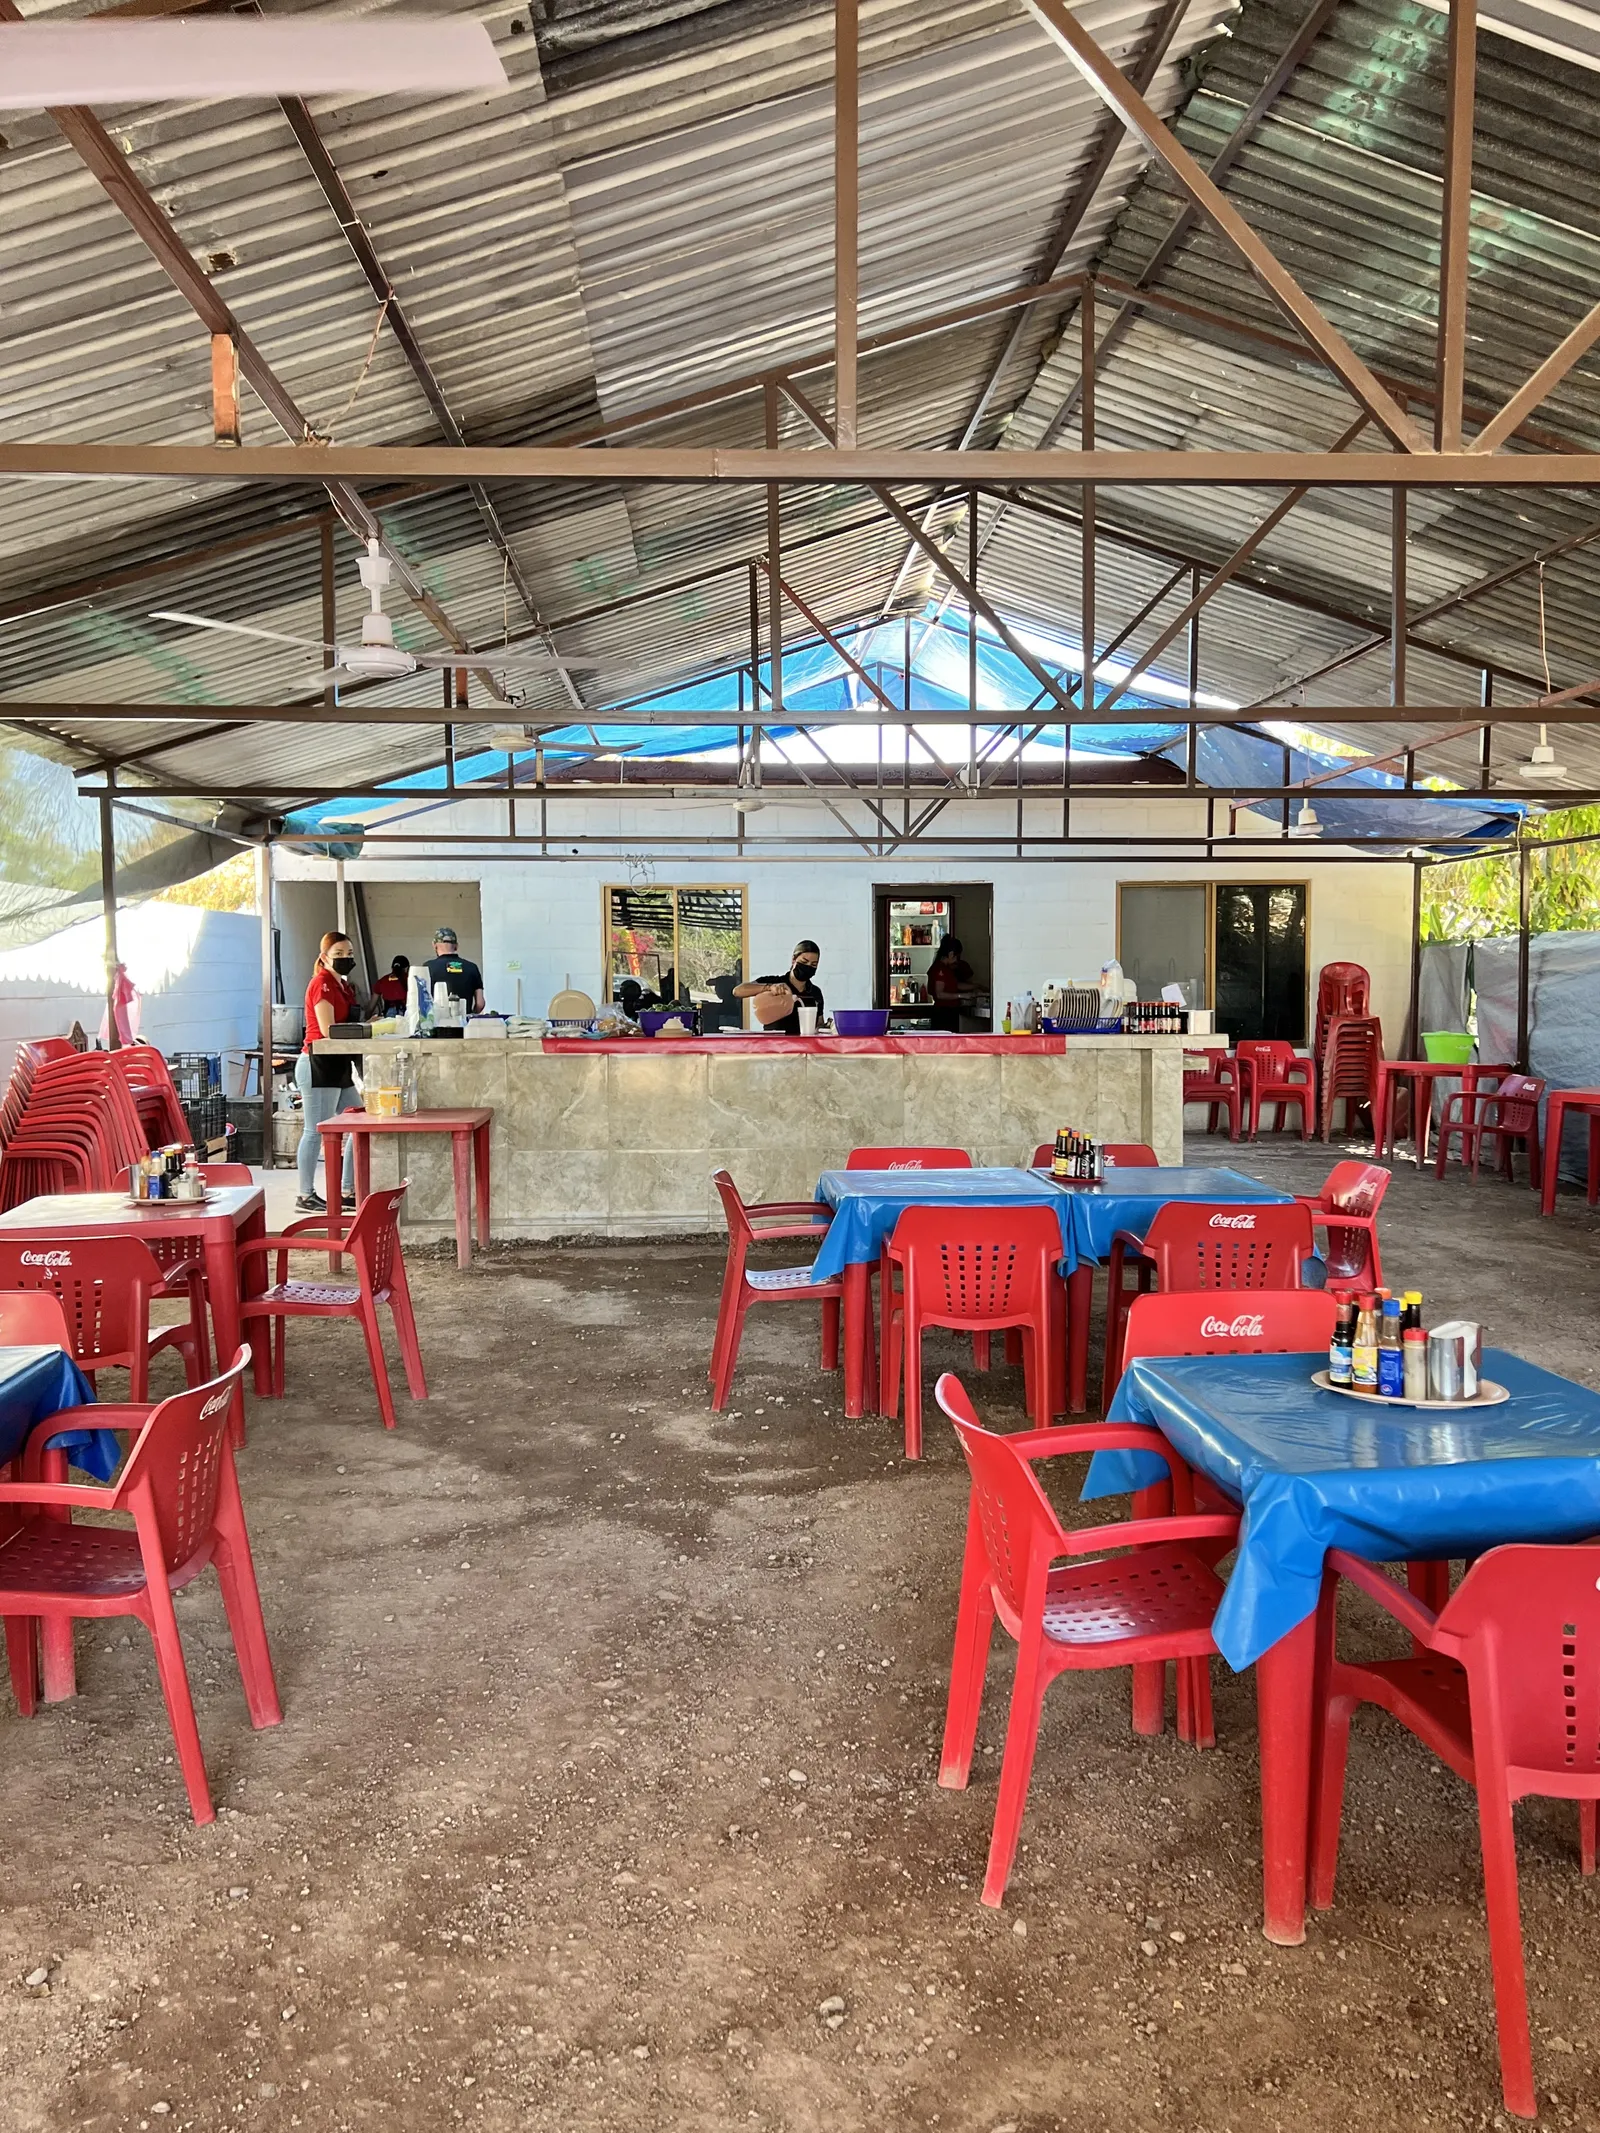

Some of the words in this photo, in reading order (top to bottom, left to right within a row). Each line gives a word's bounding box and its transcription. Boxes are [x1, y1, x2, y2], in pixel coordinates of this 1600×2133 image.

[1209, 1213, 1257, 1229] Coca-Cola
[20, 1250, 73, 1266] Coca-Cola
[1200, 1314, 1265, 1338] Coca-Cola
